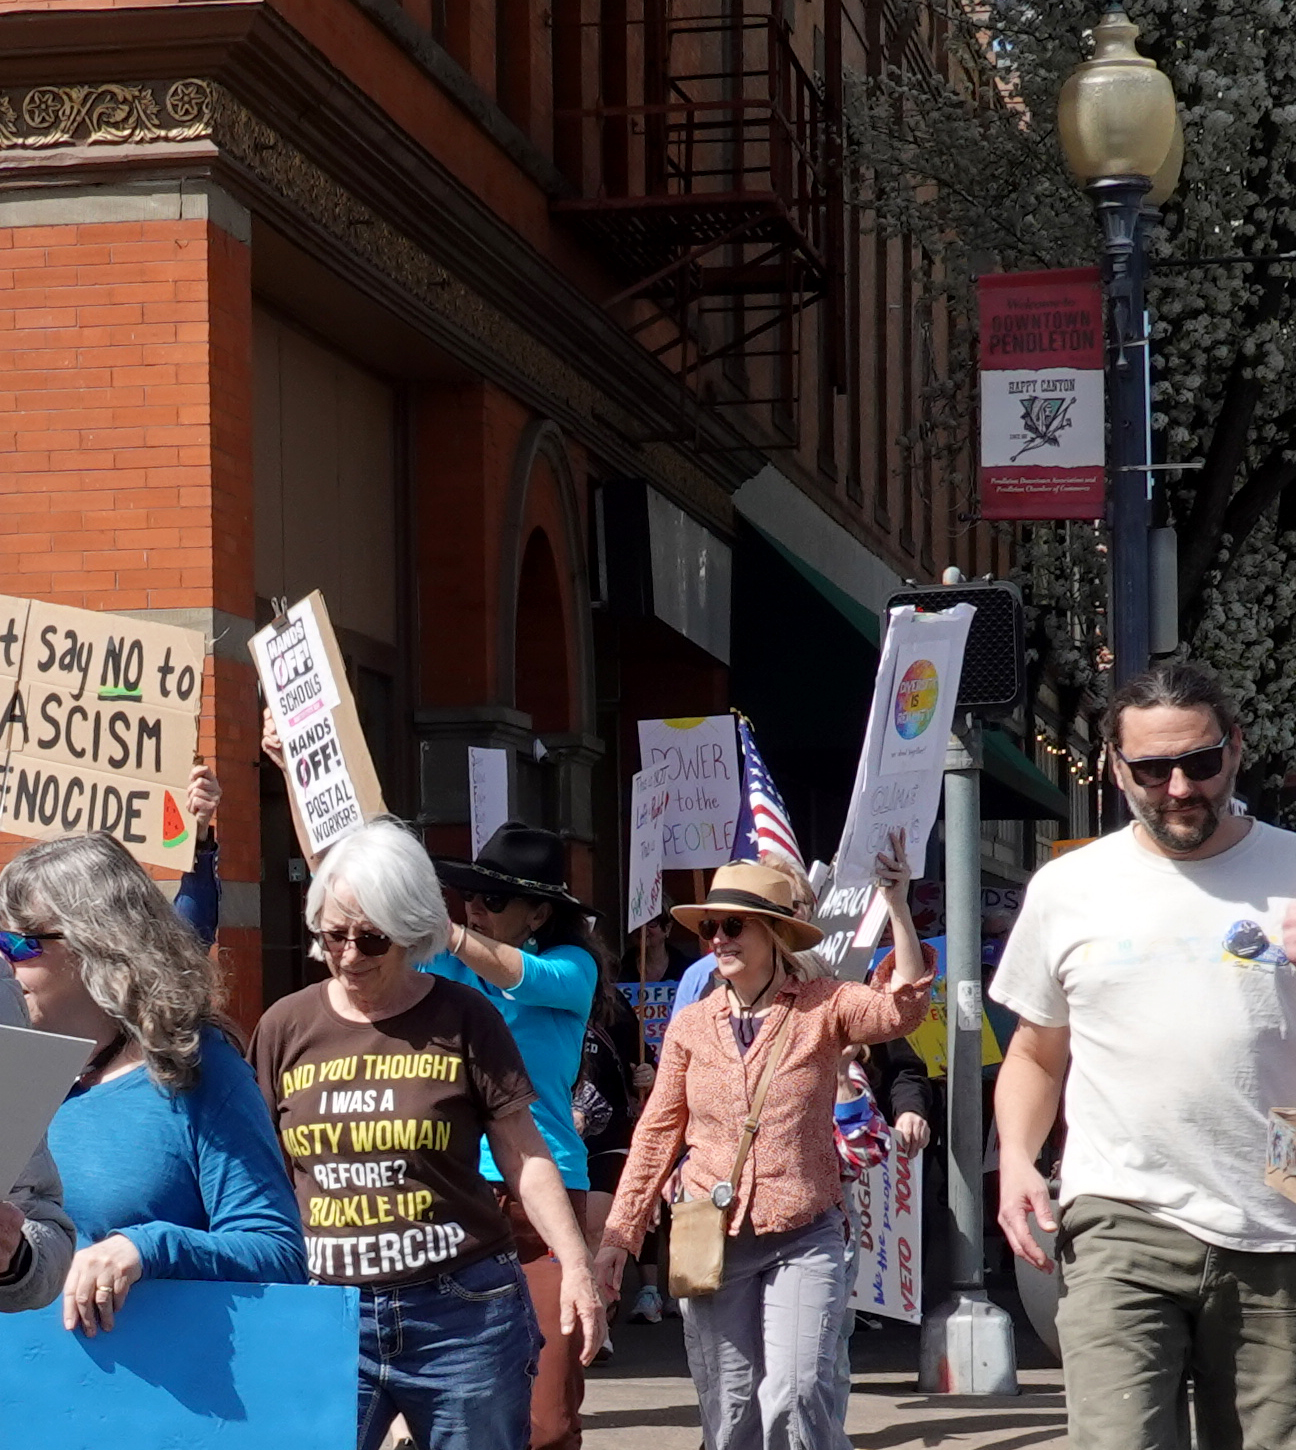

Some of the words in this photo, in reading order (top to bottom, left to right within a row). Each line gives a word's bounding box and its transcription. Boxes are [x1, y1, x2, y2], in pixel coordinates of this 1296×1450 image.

[992, 311, 1091, 332] DOWNTOWN
[989, 329, 1095, 355] PENDLETON
[1009, 380, 1038, 394] HAPPY
[1041, 378, 1076, 393] CANYON
[267, 621, 305, 656] HANDS
[100, 635, 144, 693] NO
[157, 646, 195, 701] to
[272, 641, 314, 689] OFF!
[279, 673, 322, 716] SCHOOLS
[288, 717, 331, 758] HANDS
[295, 737, 342, 790] OFF!
[305, 779, 352, 824] POSTAL
[677, 790, 694, 813] to
[696, 787, 720, 812] the
[312, 804, 358, 844] WORKERS
[662, 821, 734, 856] PEOPLE
[818, 884, 872, 919] AMERICA
[319, 1055, 358, 1083] YOU
[362, 1053, 463, 1083] THOUGHT
[319, 1091, 328, 1115] I
[332, 1090, 377, 1114] WAS
[380, 1088, 394, 1112] A
[350, 1119, 452, 1153] WOMAN
[313, 1159, 407, 1190] BEFORE?
[309, 1194, 395, 1228] BUCKLE
[304, 1221, 466, 1277] UTTERCUP
[897, 1236, 916, 1313] VETO
